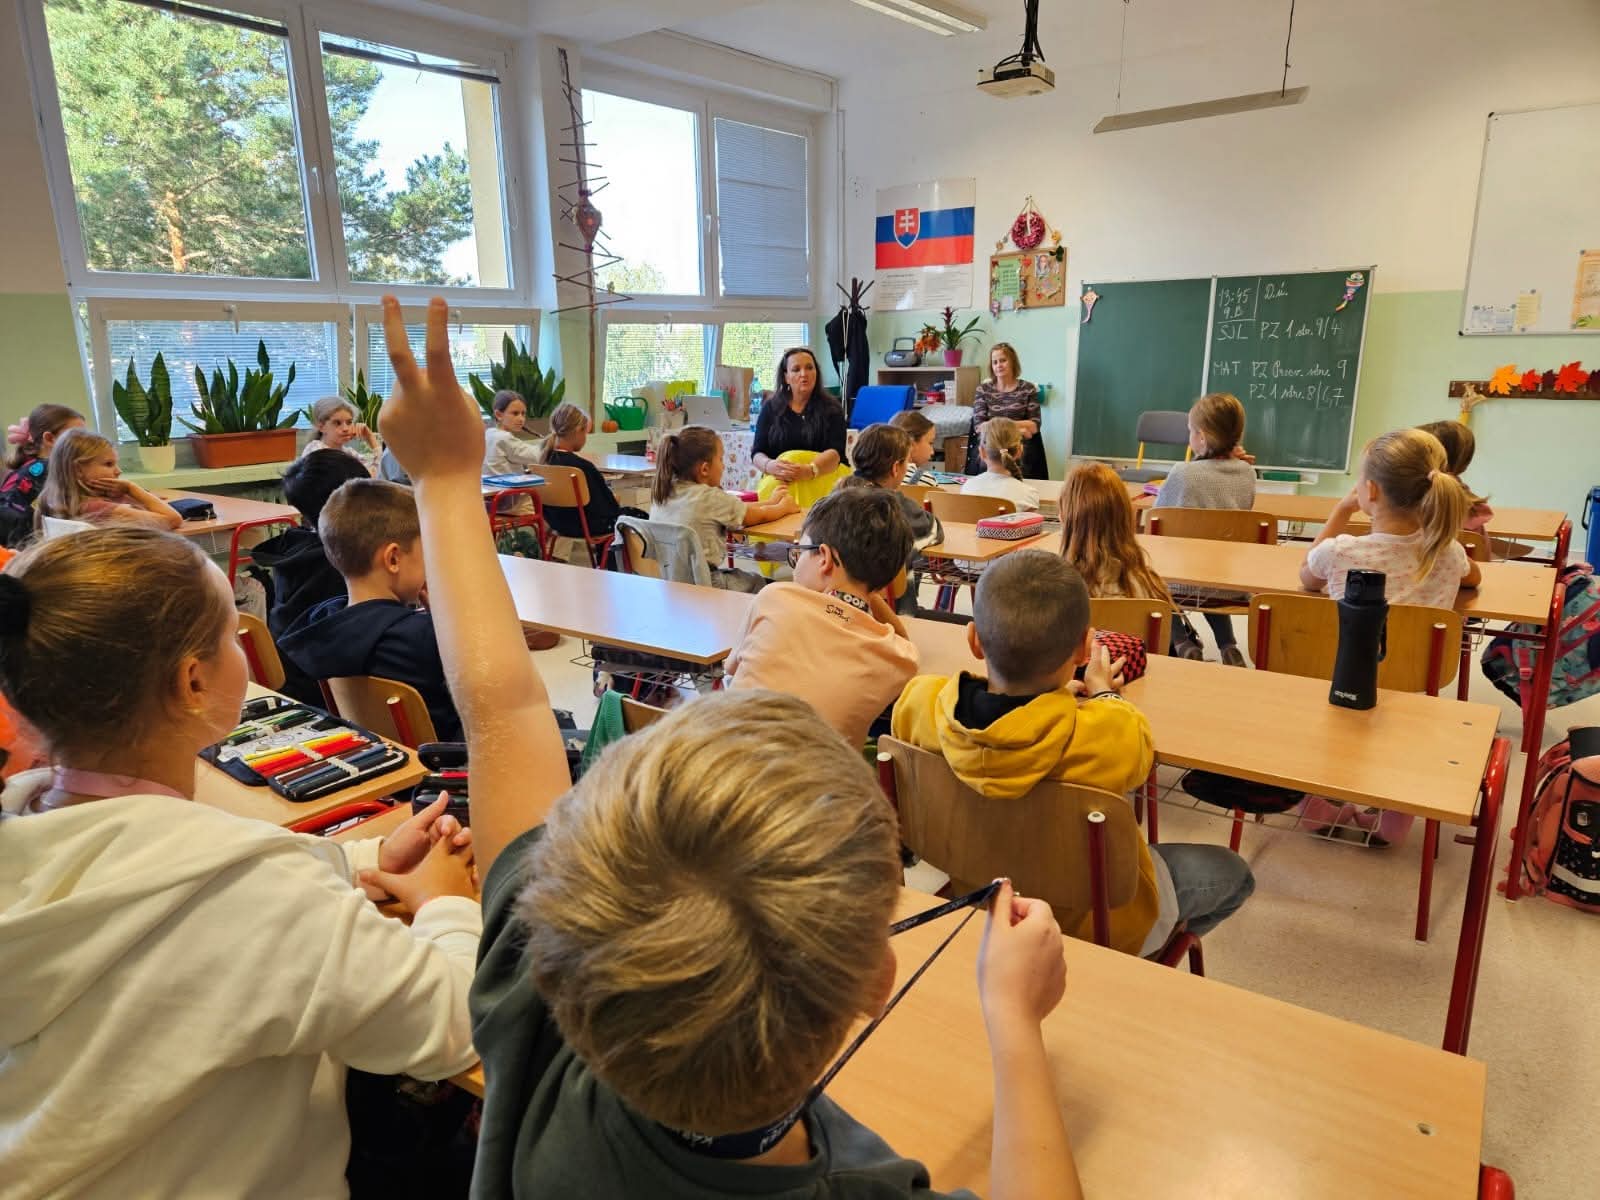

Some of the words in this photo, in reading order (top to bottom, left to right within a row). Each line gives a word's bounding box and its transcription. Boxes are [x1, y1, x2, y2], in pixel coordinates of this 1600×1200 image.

[1261, 321, 1280, 339] PZ
[1286, 319, 1294, 338] 1
[1213, 360, 1240, 376] MAT
[1252, 361, 1268, 378] PZ
[1337, 359, 1347, 379] 9
[1250, 383, 1267, 400] PZ
[1269, 383, 1277, 400] 1
